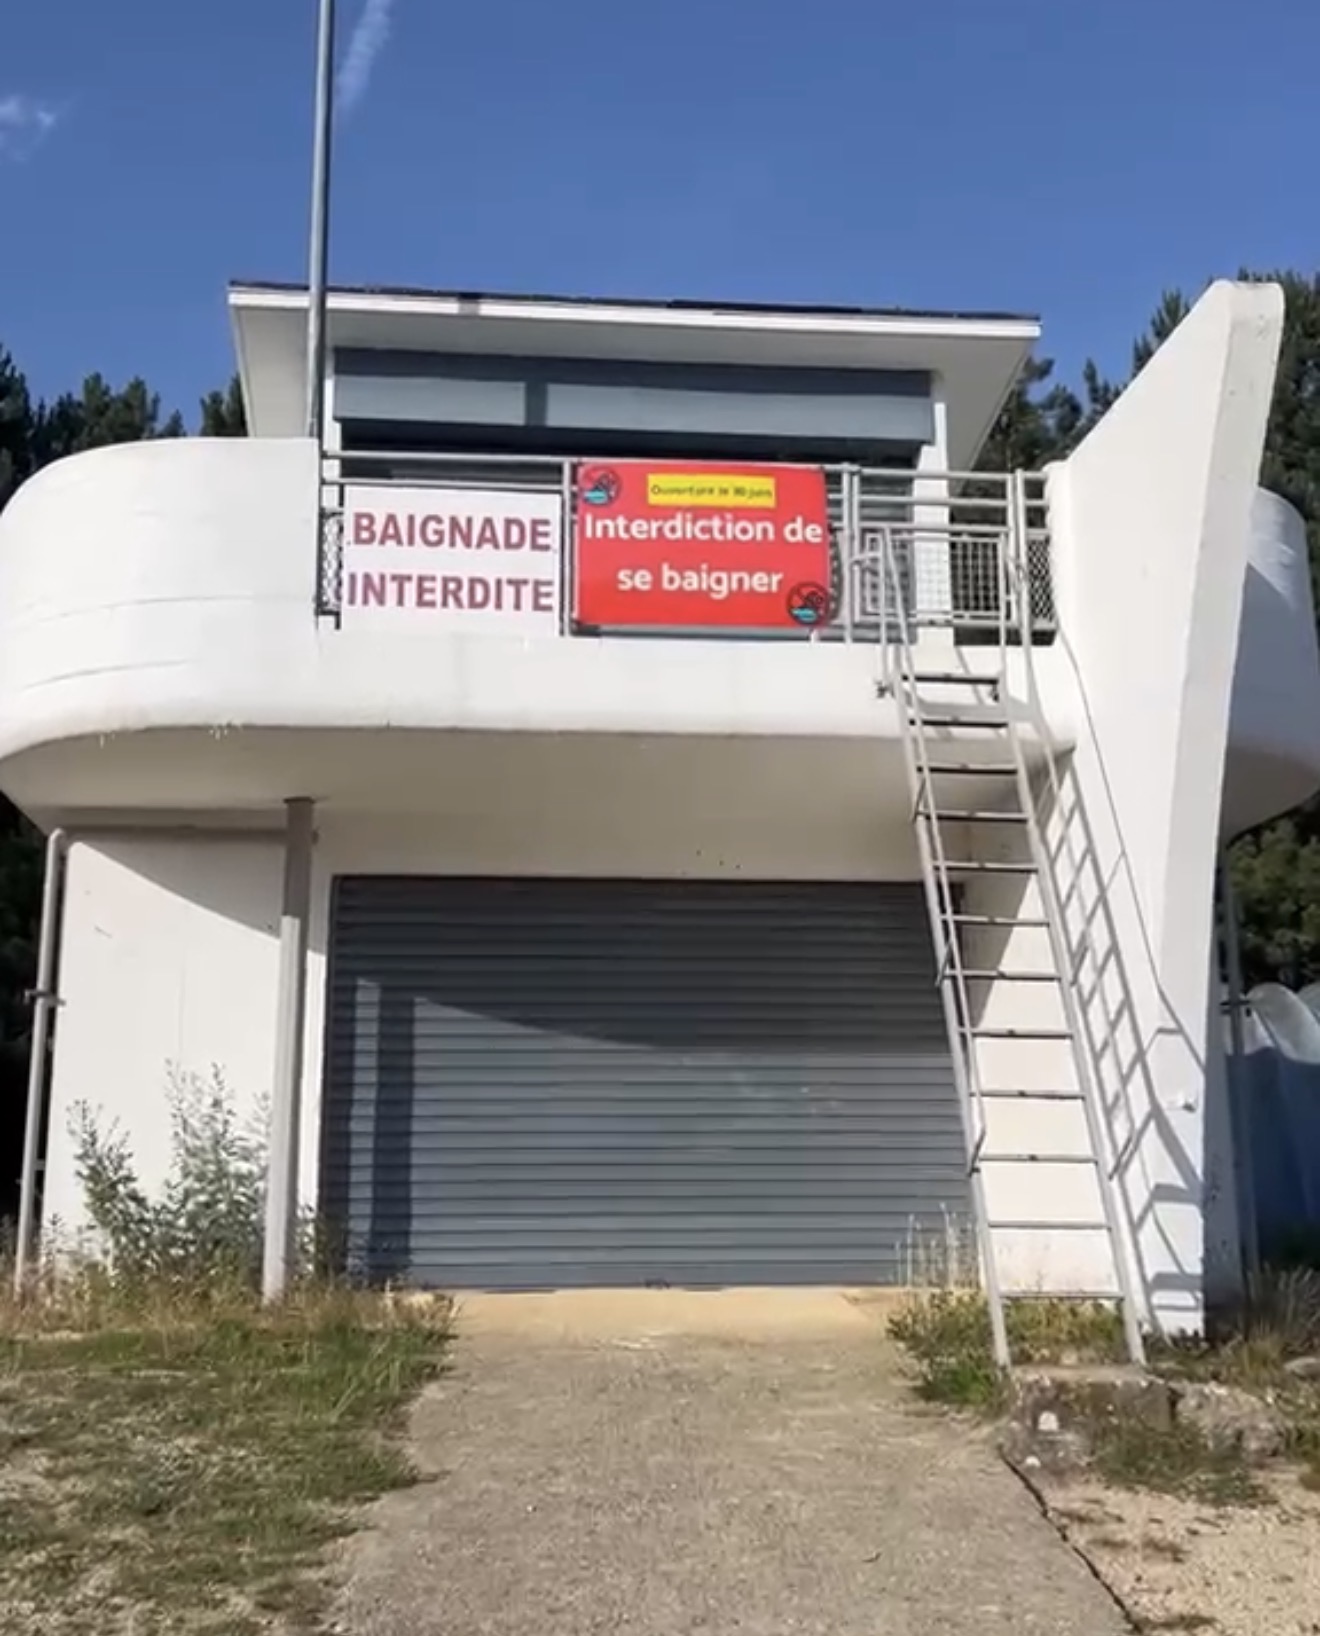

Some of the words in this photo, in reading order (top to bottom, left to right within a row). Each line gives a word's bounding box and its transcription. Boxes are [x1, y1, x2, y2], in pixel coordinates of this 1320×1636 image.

[353, 511, 552, 552] BAIGNADE
[584, 513, 776, 542] Interdiction
[783, 517, 824, 543] de
[347, 571, 554, 612] INTERDITE
[616, 568, 653, 590] se
[661, 563, 783, 600] baigner
